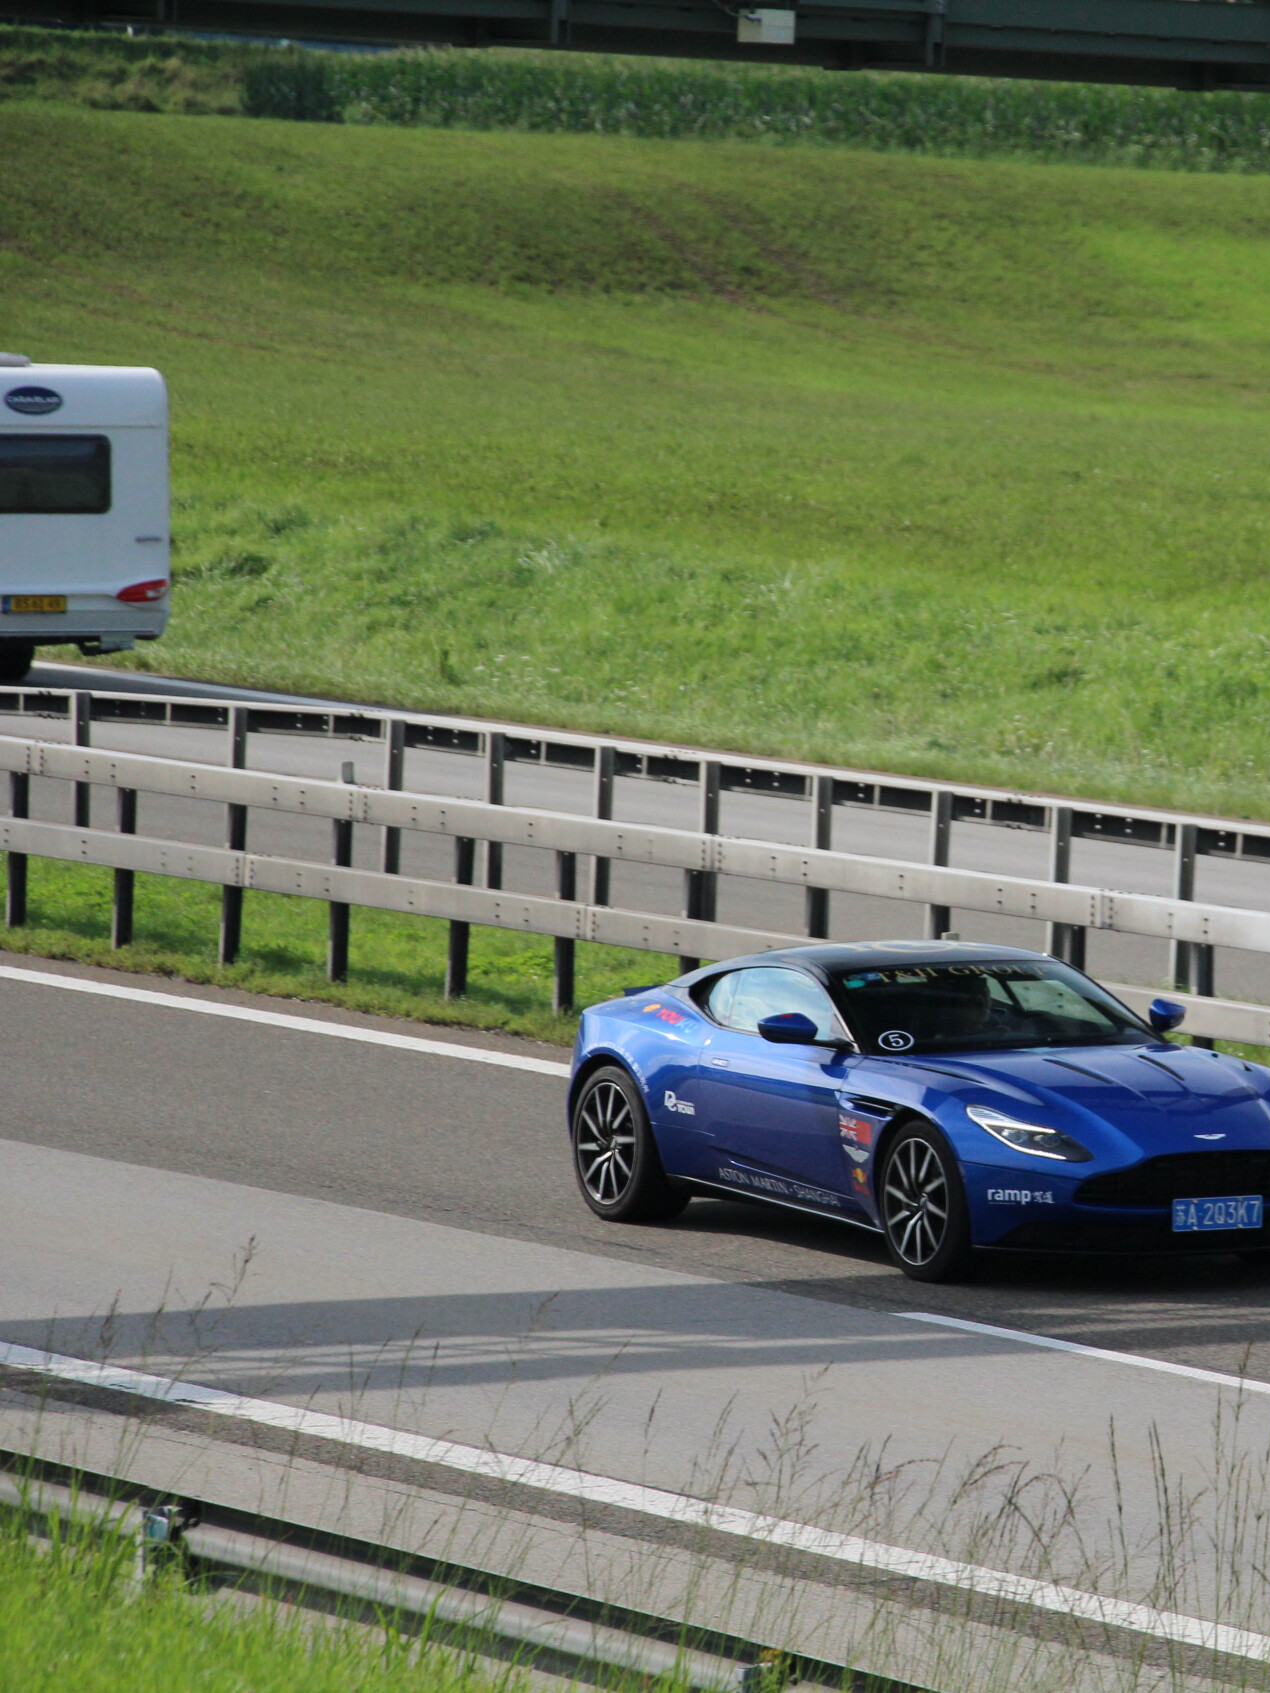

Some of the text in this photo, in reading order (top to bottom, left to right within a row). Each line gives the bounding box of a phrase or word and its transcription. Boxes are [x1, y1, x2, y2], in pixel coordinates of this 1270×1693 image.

[947, 964, 1048, 976] GROUP
[888, 1033, 905, 1047] 5
[718, 1167, 749, 1184] ASTON
[750, 1175, 789, 1195] MARTIN
[987, 1188, 1031, 1205] ramp
